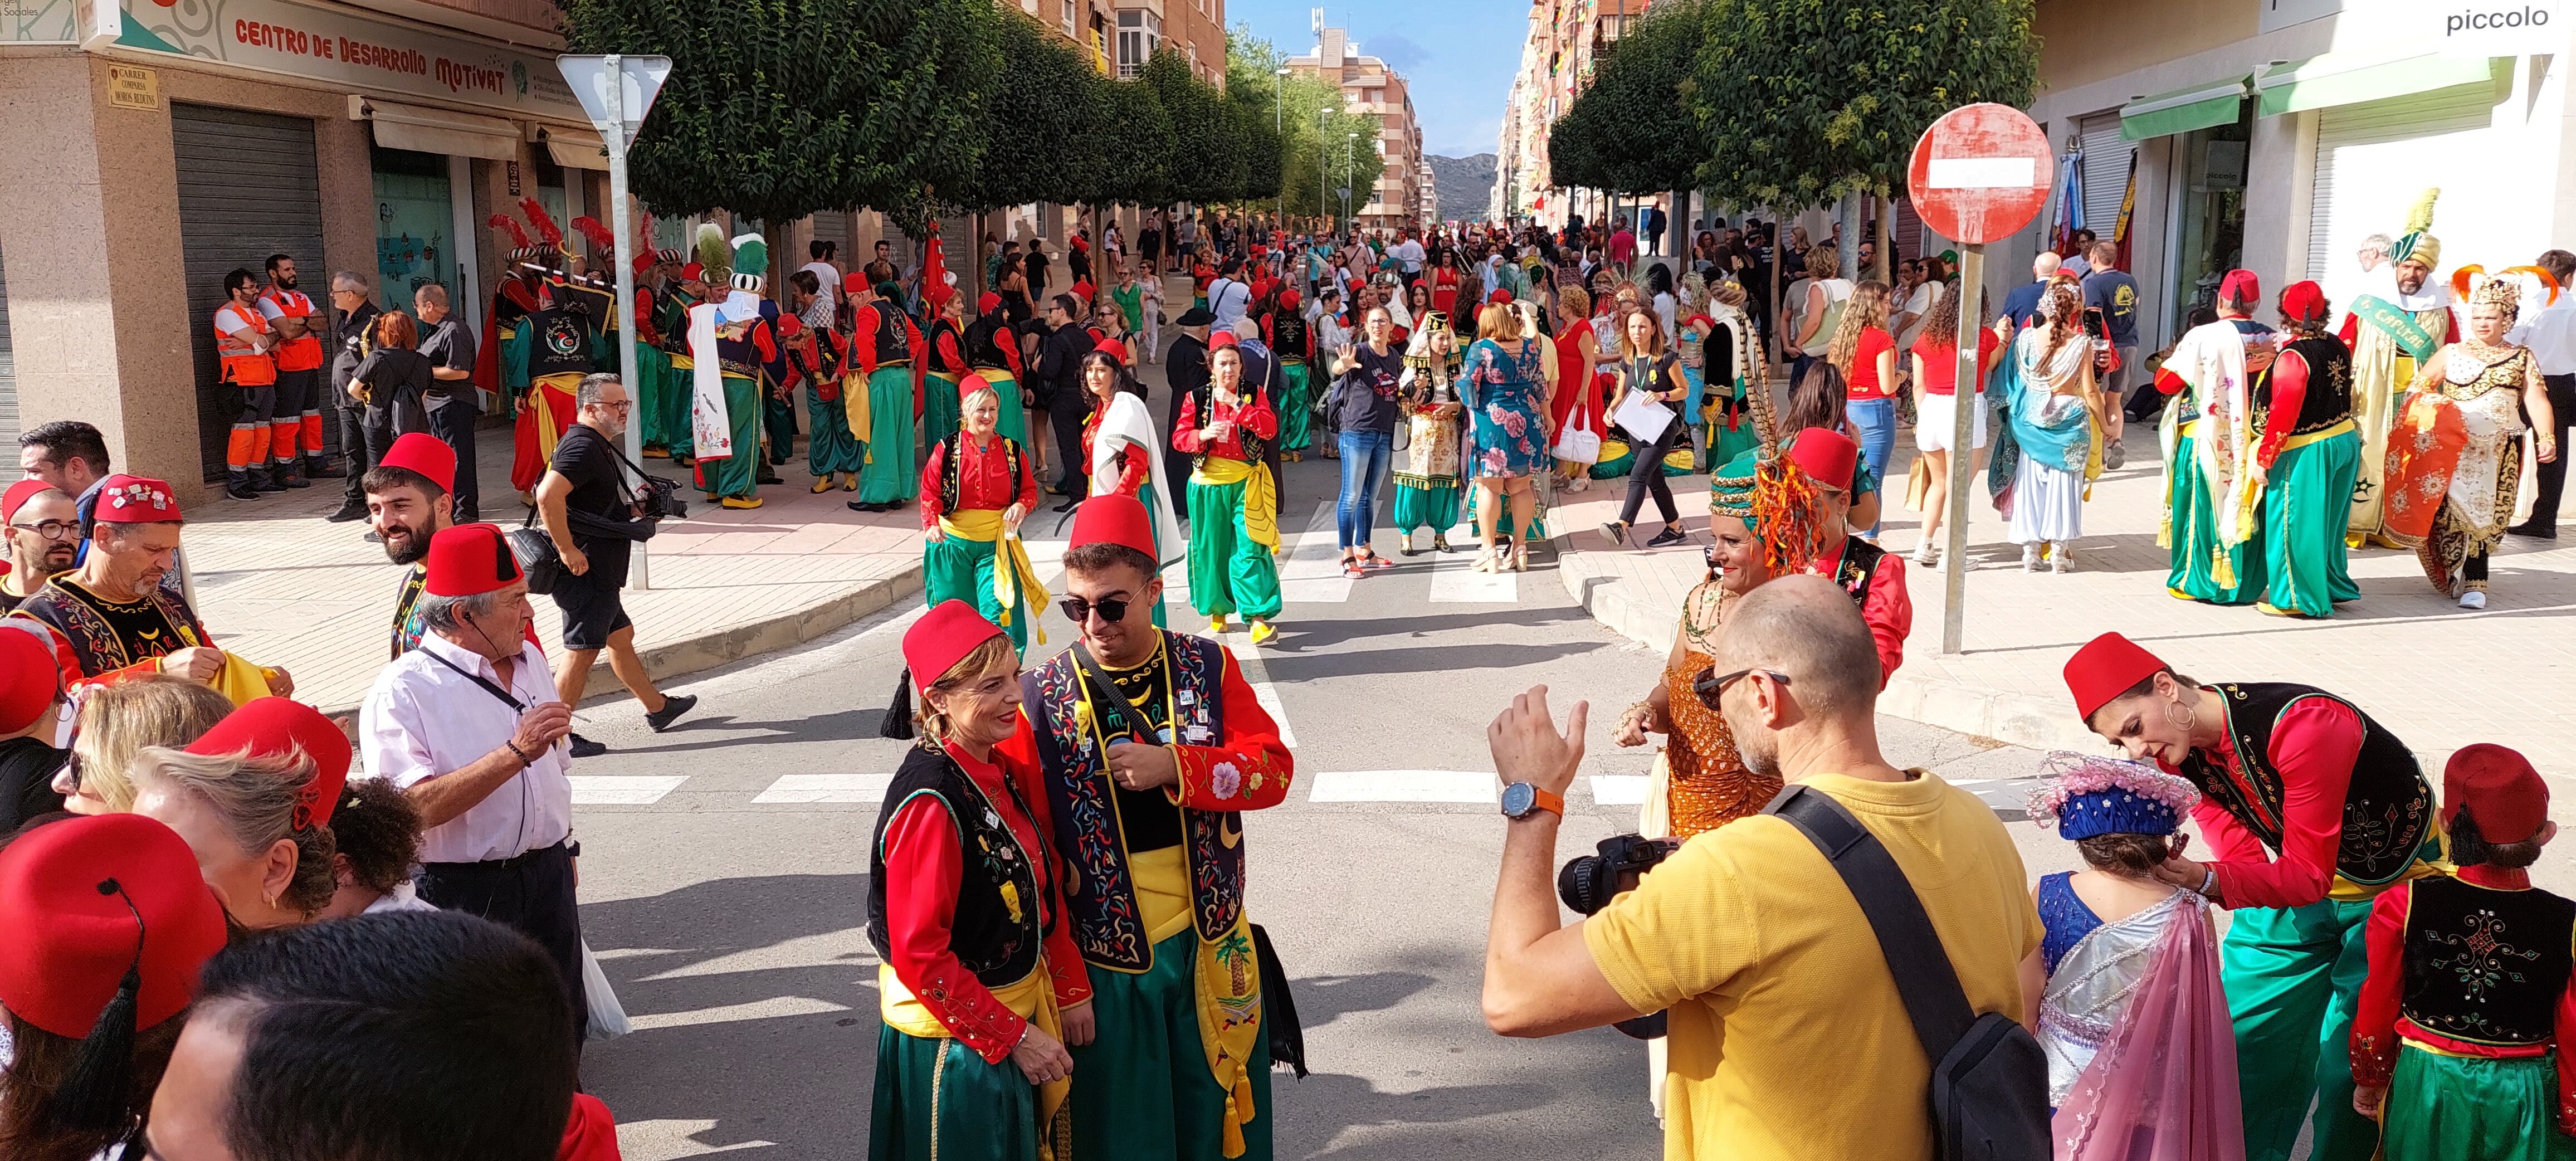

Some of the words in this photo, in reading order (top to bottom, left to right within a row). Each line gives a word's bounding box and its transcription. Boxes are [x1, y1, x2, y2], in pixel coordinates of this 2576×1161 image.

[4, 6, 38, 17] Sociales
[2447, 6, 2549, 37] piccolo
[313, 35, 333, 59] DE
[119, 69, 147, 80] CARRER
[121, 80, 146, 91] COMPARSA
[115, 91, 133, 103] MOROS
